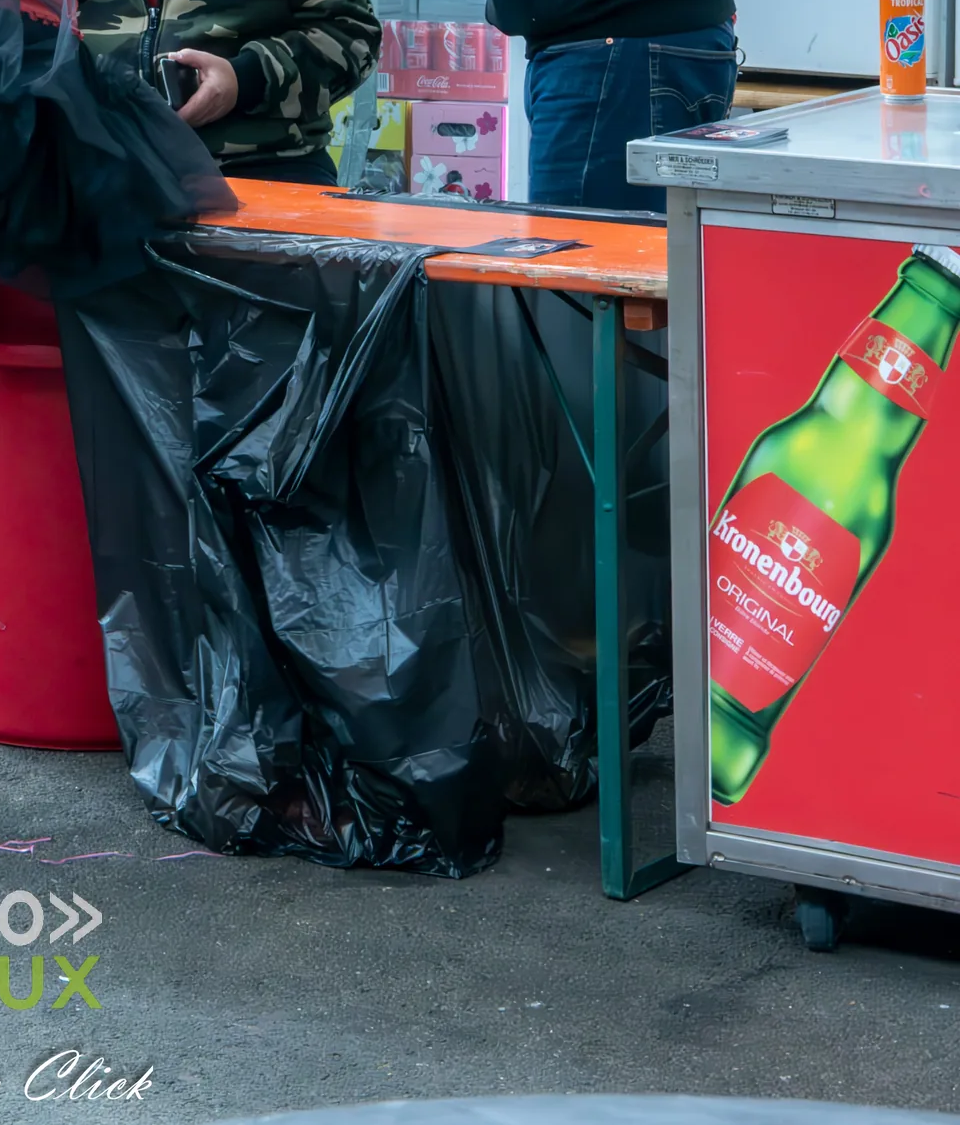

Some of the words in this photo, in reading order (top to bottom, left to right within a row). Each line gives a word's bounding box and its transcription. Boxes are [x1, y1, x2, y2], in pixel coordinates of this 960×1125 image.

[884, 16, 925, 62] Oasis
[713, 509, 842, 632] Kronenbourg
[714, 618, 744, 648] VERRE
[716, 575, 795, 646] ORIGINAL
